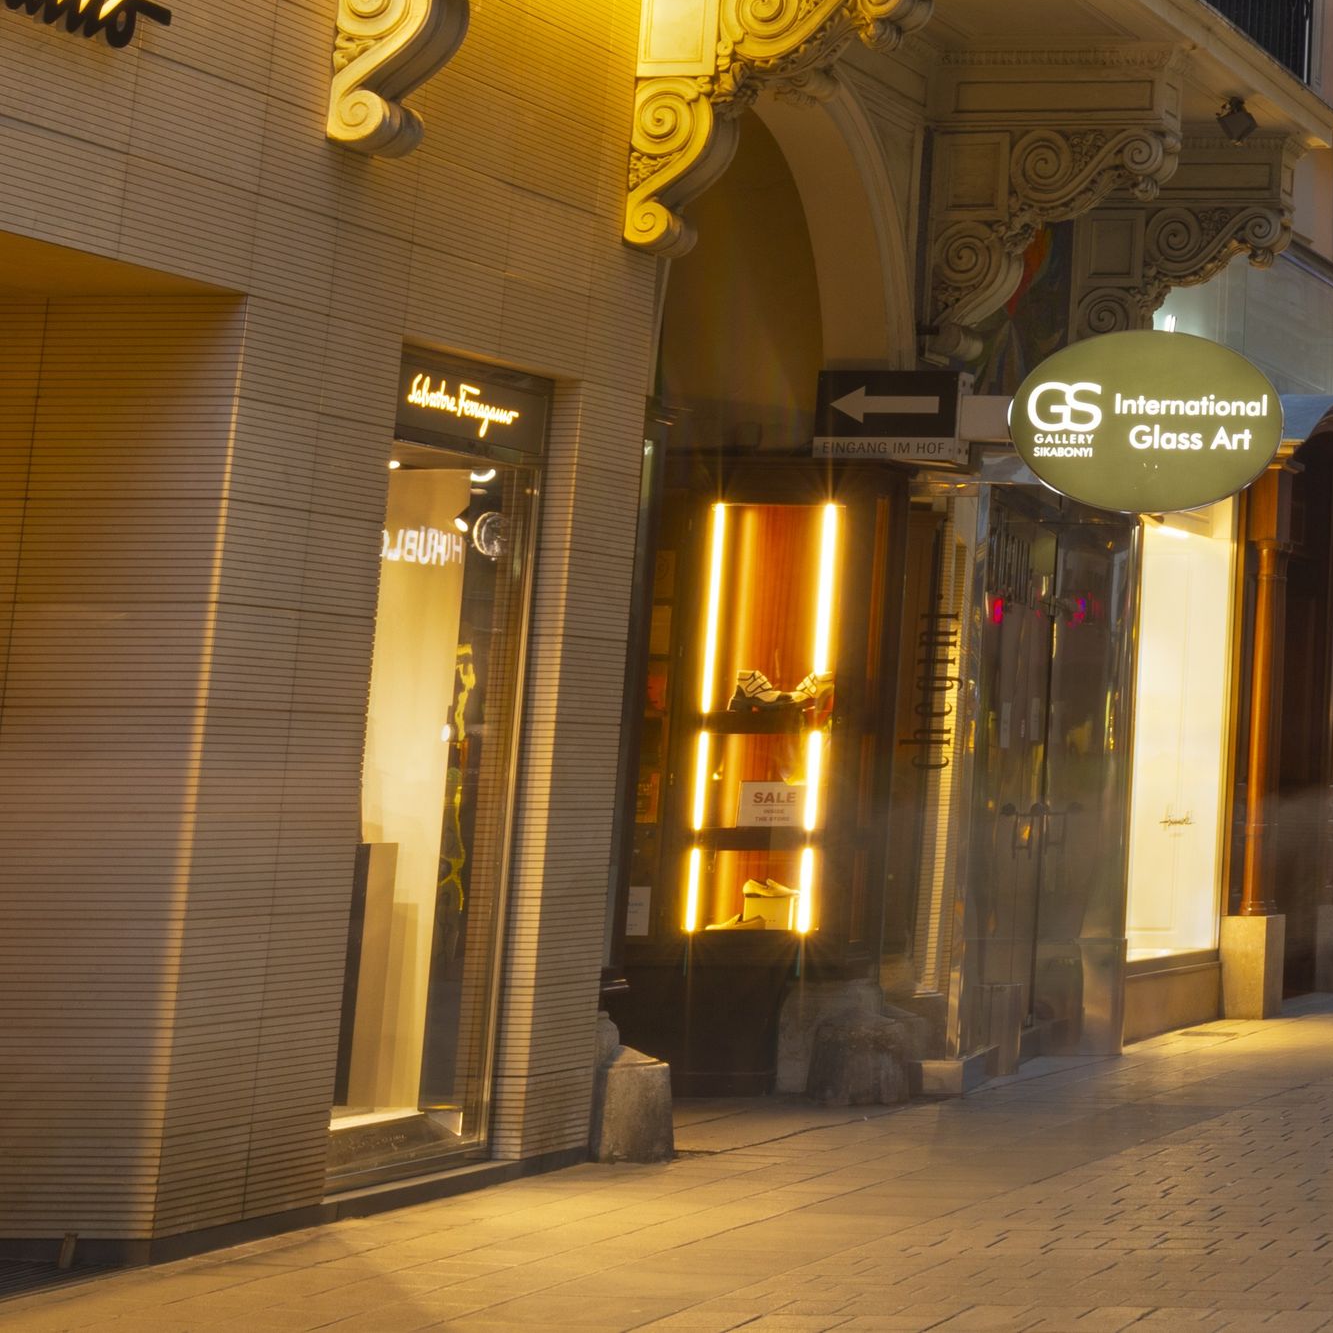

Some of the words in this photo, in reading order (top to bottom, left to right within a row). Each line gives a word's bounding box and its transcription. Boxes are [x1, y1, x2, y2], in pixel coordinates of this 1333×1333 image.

[408, 374, 457, 412] Salvatore
[457, 383, 519, 438] Ferragamo
[1027, 382, 1103, 433] GS
[1115, 393, 1268, 417] International
[1034, 433, 1094, 445] GALLERY
[1129, 424, 1203, 451] Glass
[1210, 425, 1252, 451] Art
[822, 441, 887, 454] EINGANG
[893, 442, 911, 454] IM
[916, 442, 945, 455] HOF
[1033, 446, 1093, 458] SIKABONYI
[753, 791, 797, 804] SALE
